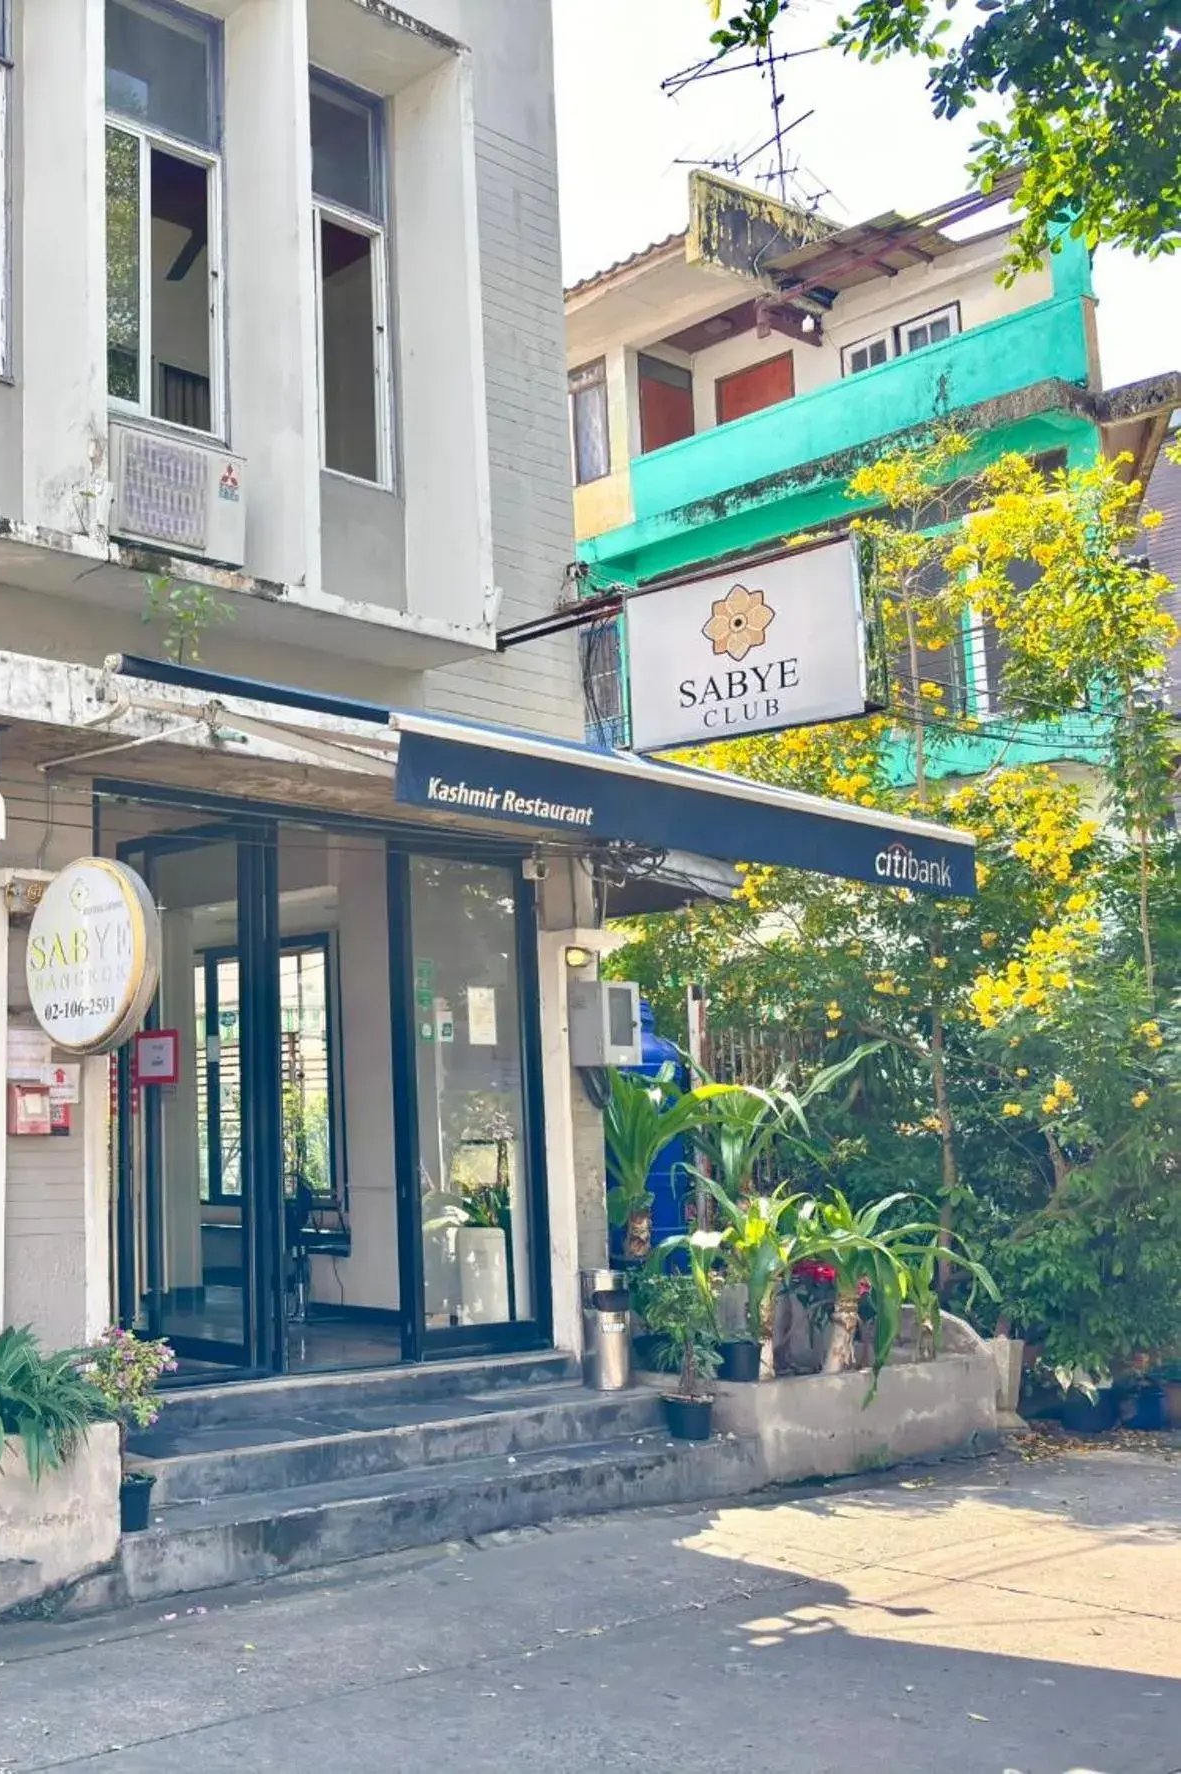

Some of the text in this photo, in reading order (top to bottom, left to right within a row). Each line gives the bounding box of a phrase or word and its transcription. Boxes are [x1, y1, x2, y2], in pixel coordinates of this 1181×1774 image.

[679, 657, 800, 709] SABYE
[703, 698, 780, 729] CLUB
[427, 776, 594, 826] Kashmir Restaurant
[874, 847, 952, 889] citibank
[44, 996, 117, 1022] 02-106-2591
